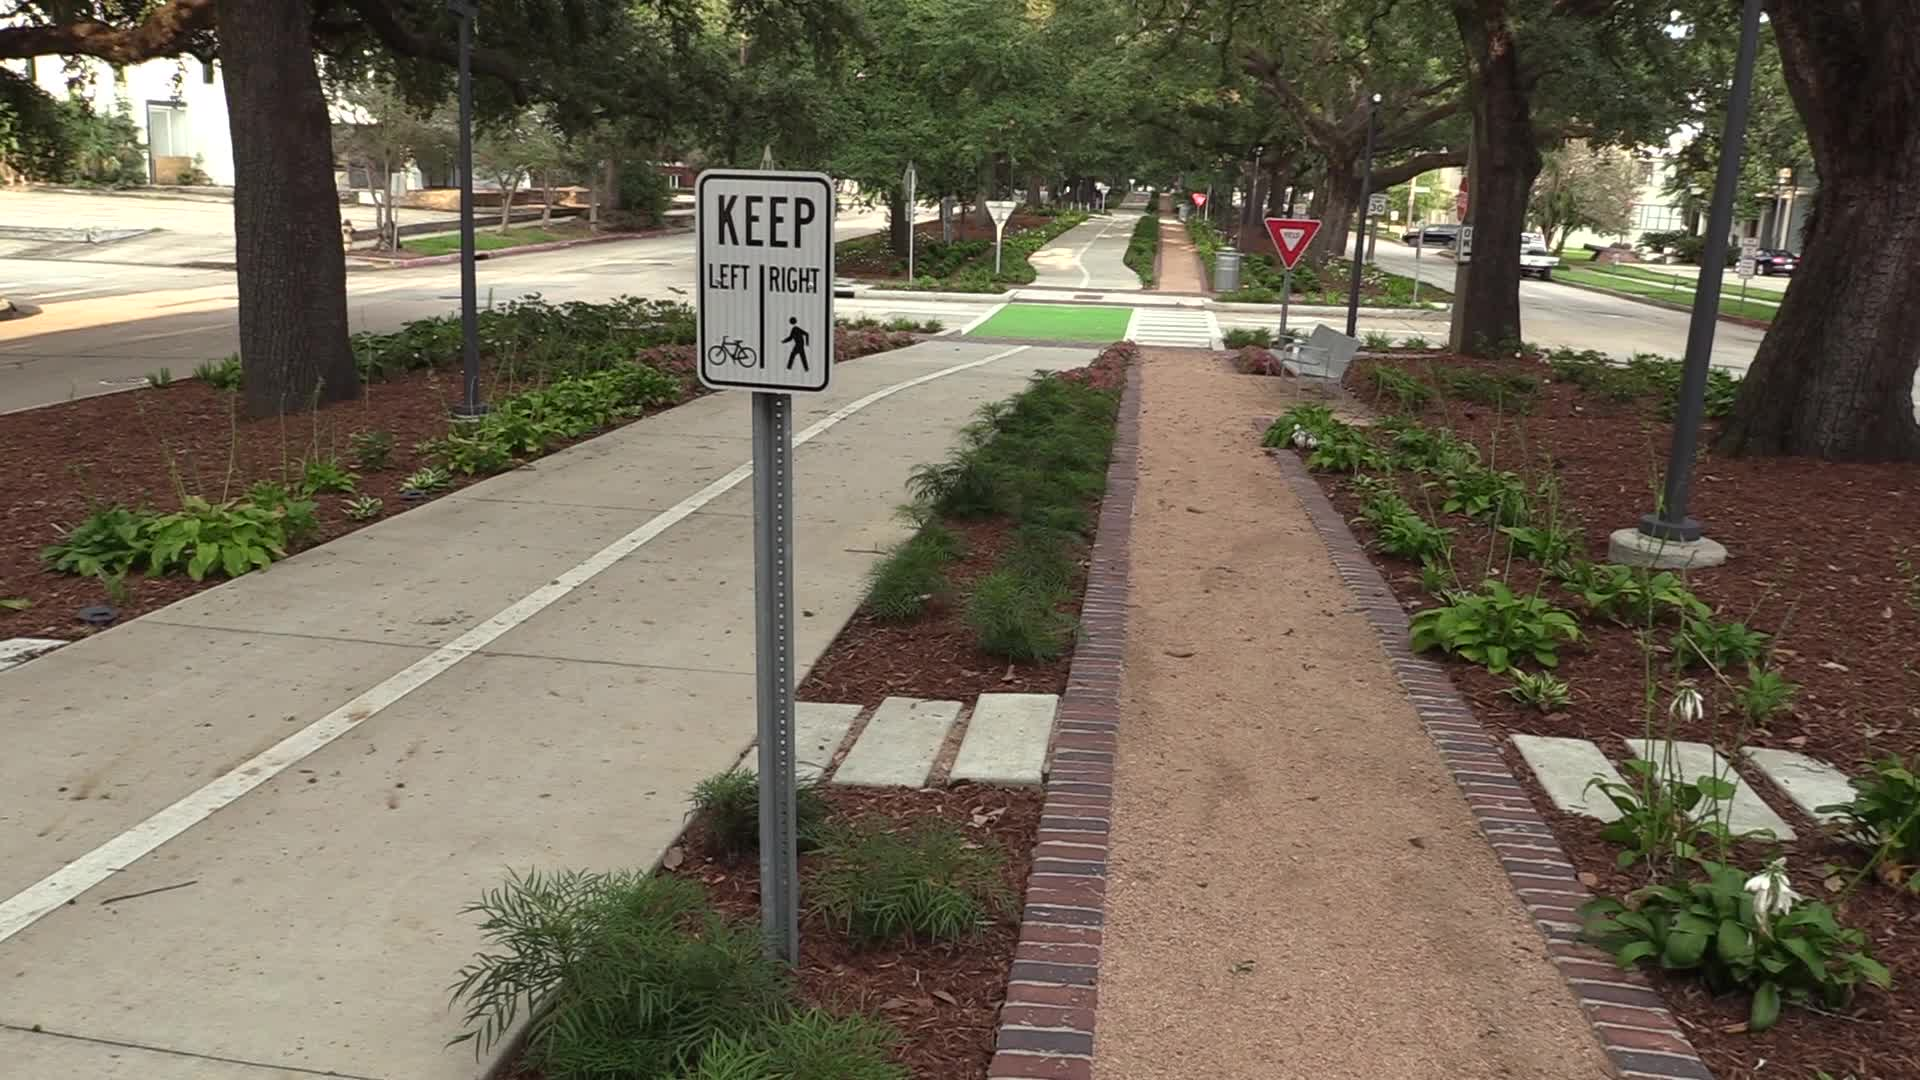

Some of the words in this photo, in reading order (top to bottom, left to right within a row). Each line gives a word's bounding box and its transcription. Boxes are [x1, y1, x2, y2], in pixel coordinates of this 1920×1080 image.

[1370, 203, 1384, 212] 30
[718, 195, 815, 248] KEEP
[1283, 231, 1300, 239] YIELD
[709, 263, 750, 290] LEFT
[769, 266, 819, 294] RIGHT
